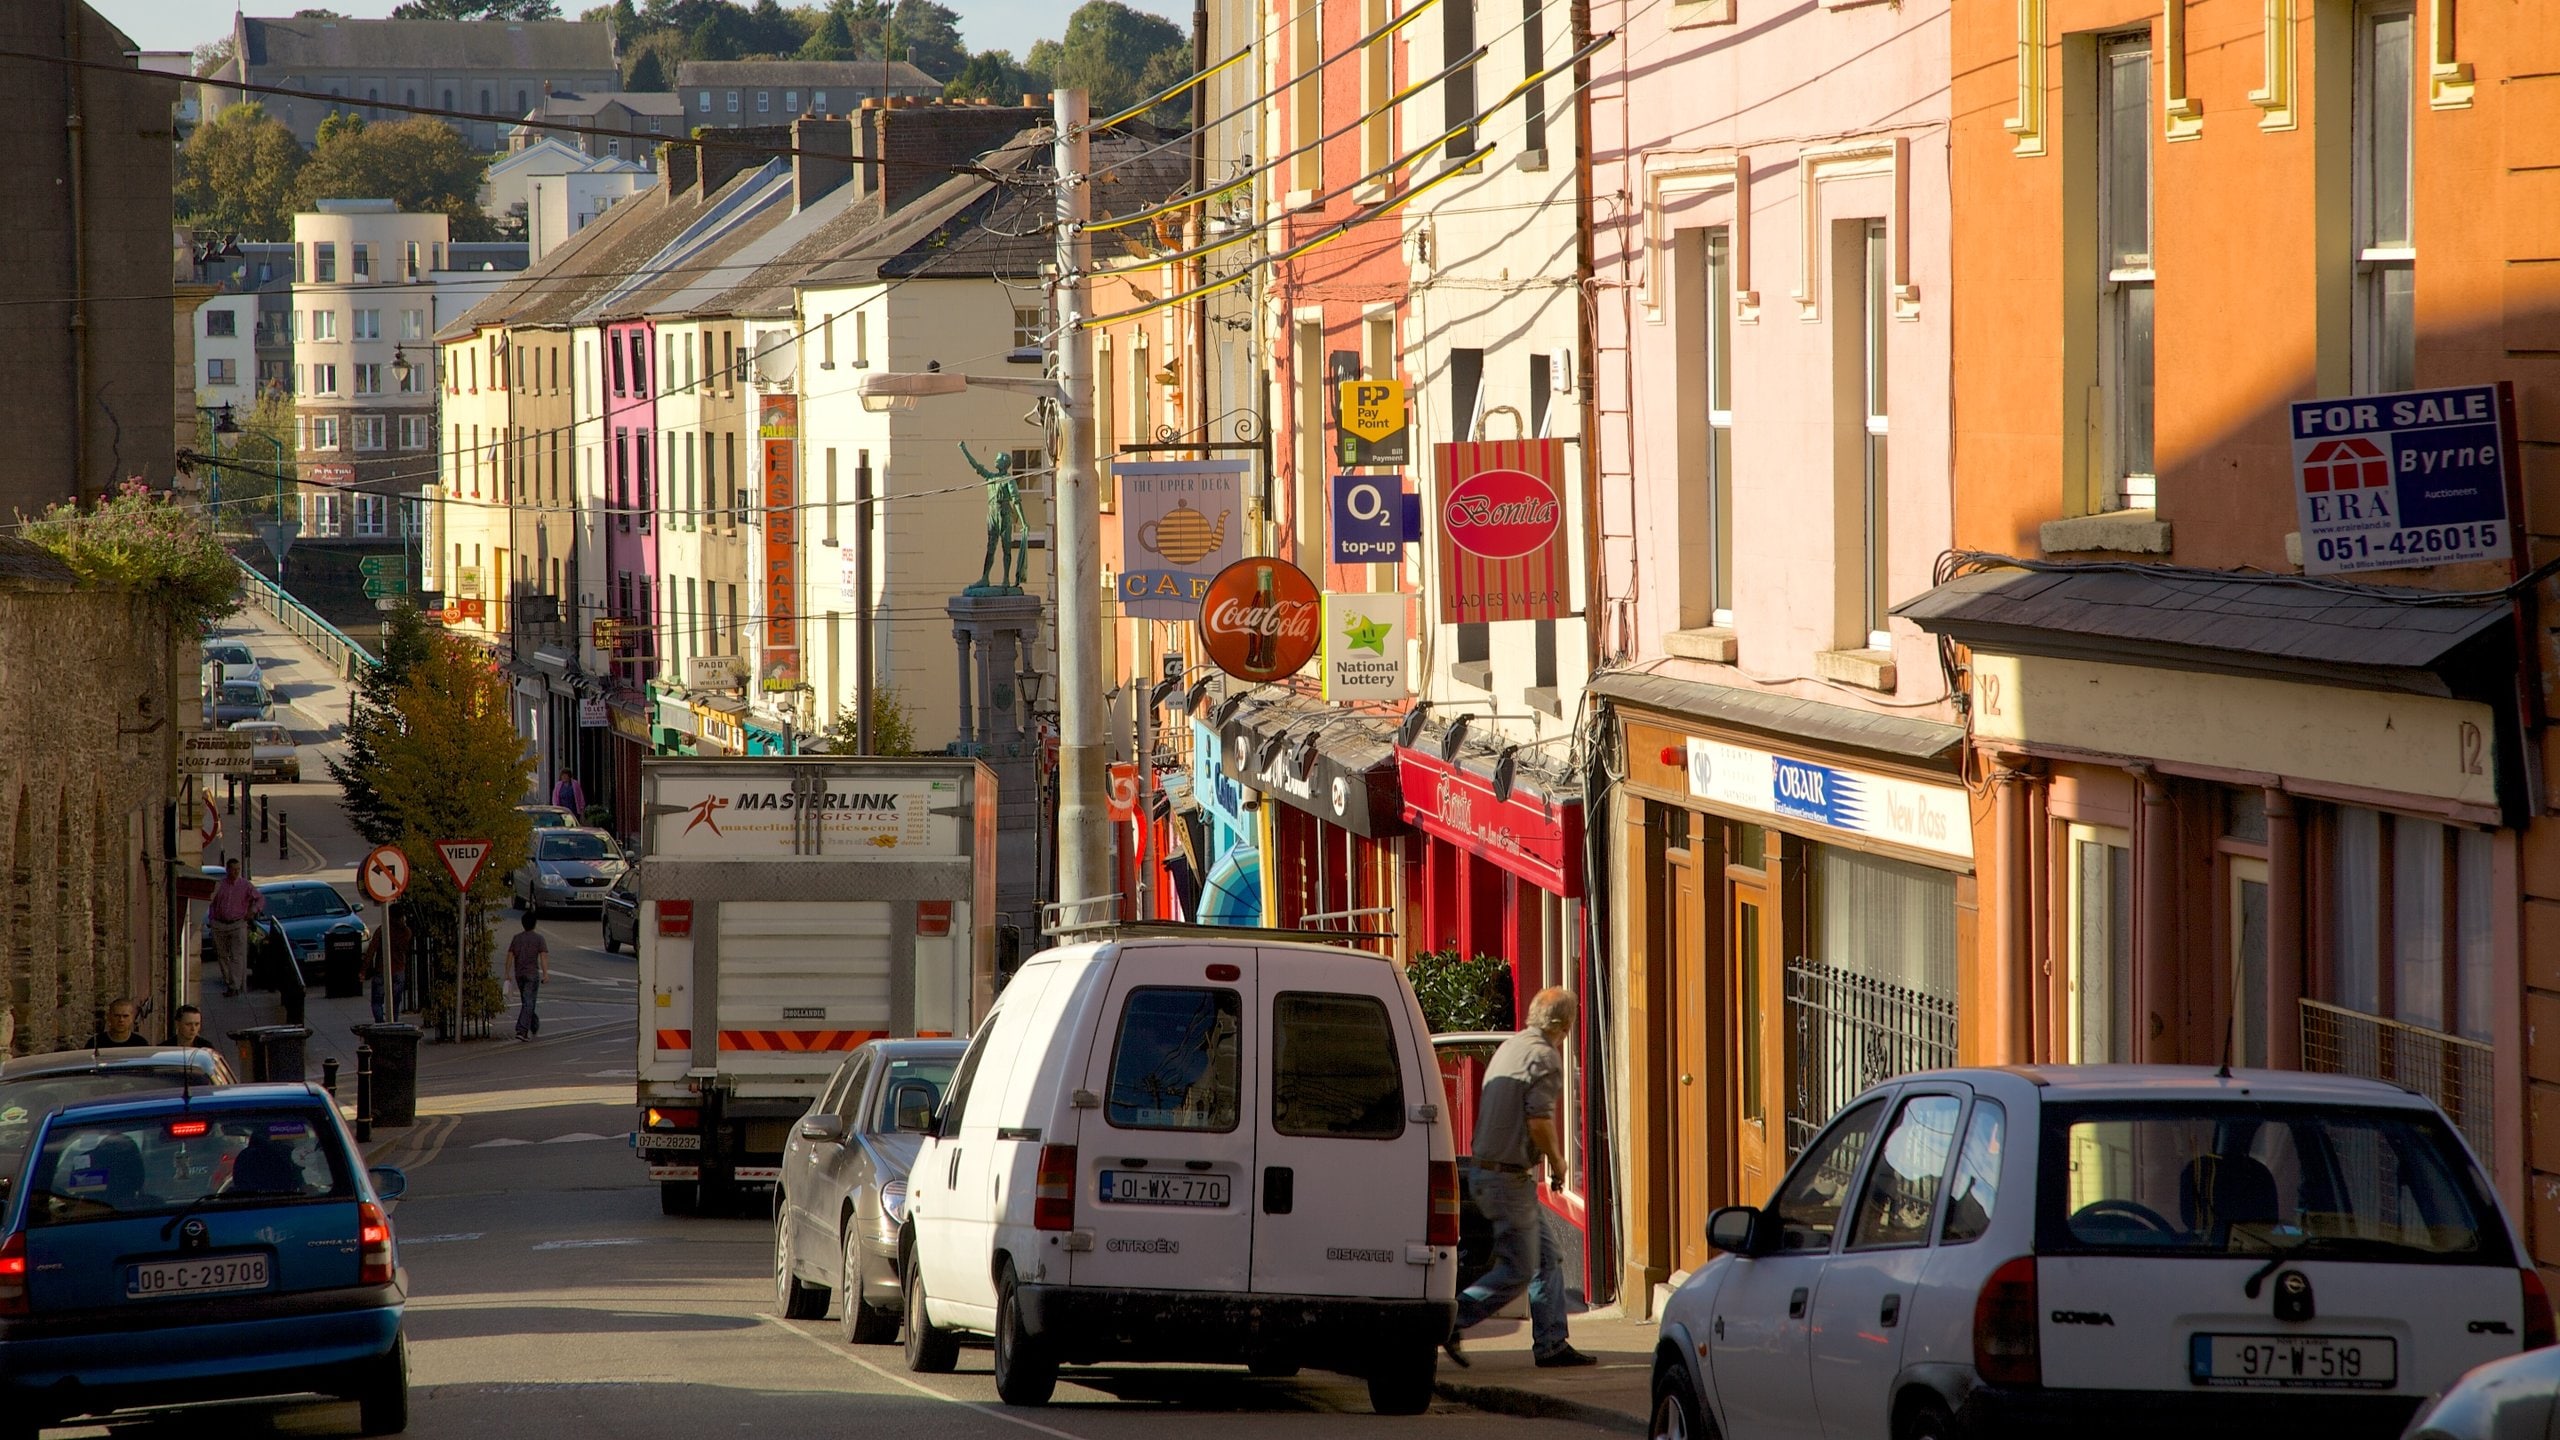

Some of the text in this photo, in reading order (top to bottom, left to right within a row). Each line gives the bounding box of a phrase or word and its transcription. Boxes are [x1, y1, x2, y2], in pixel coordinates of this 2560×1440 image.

[1357, 408, 1379, 420] Pay
[2301, 394, 2488, 434] FOR SALE
[1357, 418, 1390, 429] Point
[1372, 455, 1403, 463] Payment
[2400, 444, 2496, 474] Byrne
[1133, 478, 1231, 493] THE UPPER DECK
[2424, 487, 2478, 499] Auctioneers
[1448, 494, 1556, 528] Bonita
[2308, 491, 2391, 523] ERA
[2312, 520, 2392, 535] www.eraireland.ie
[1341, 540, 1396, 555] top-up
[2317, 524, 2497, 562] 051-426015
[2340, 550, 2484, 571] Each Office Independently Owned and Operated
[1126, 574, 1208, 599] CAF
[771, 560, 791, 644] PALACE
[1450, 591, 1560, 608] LADIES WEAR
[698, 661, 729, 669] PADDY
[1336, 660, 1399, 673] National
[1341, 674, 1395, 687] Lottery
[1982, 674, 2001, 716] 12
[186, 738, 251, 750] STANDARD
[2457, 719, 2483, 775] 12
[191, 757, 251, 766] 051-421184
[1779, 765, 1827, 806] OBAIR
[735, 792, 899, 811] MASTERLINK
[794, 812, 900, 822] LOGISTICS
[1886, 789, 1947, 841] New Ross
[446, 847, 480, 859] YIELD
[1121, 1179, 1221, 1201] 01-WX-770
[1106, 1238, 1179, 1254] CITROËN
[1326, 1247, 1394, 1263] DISPATCH
